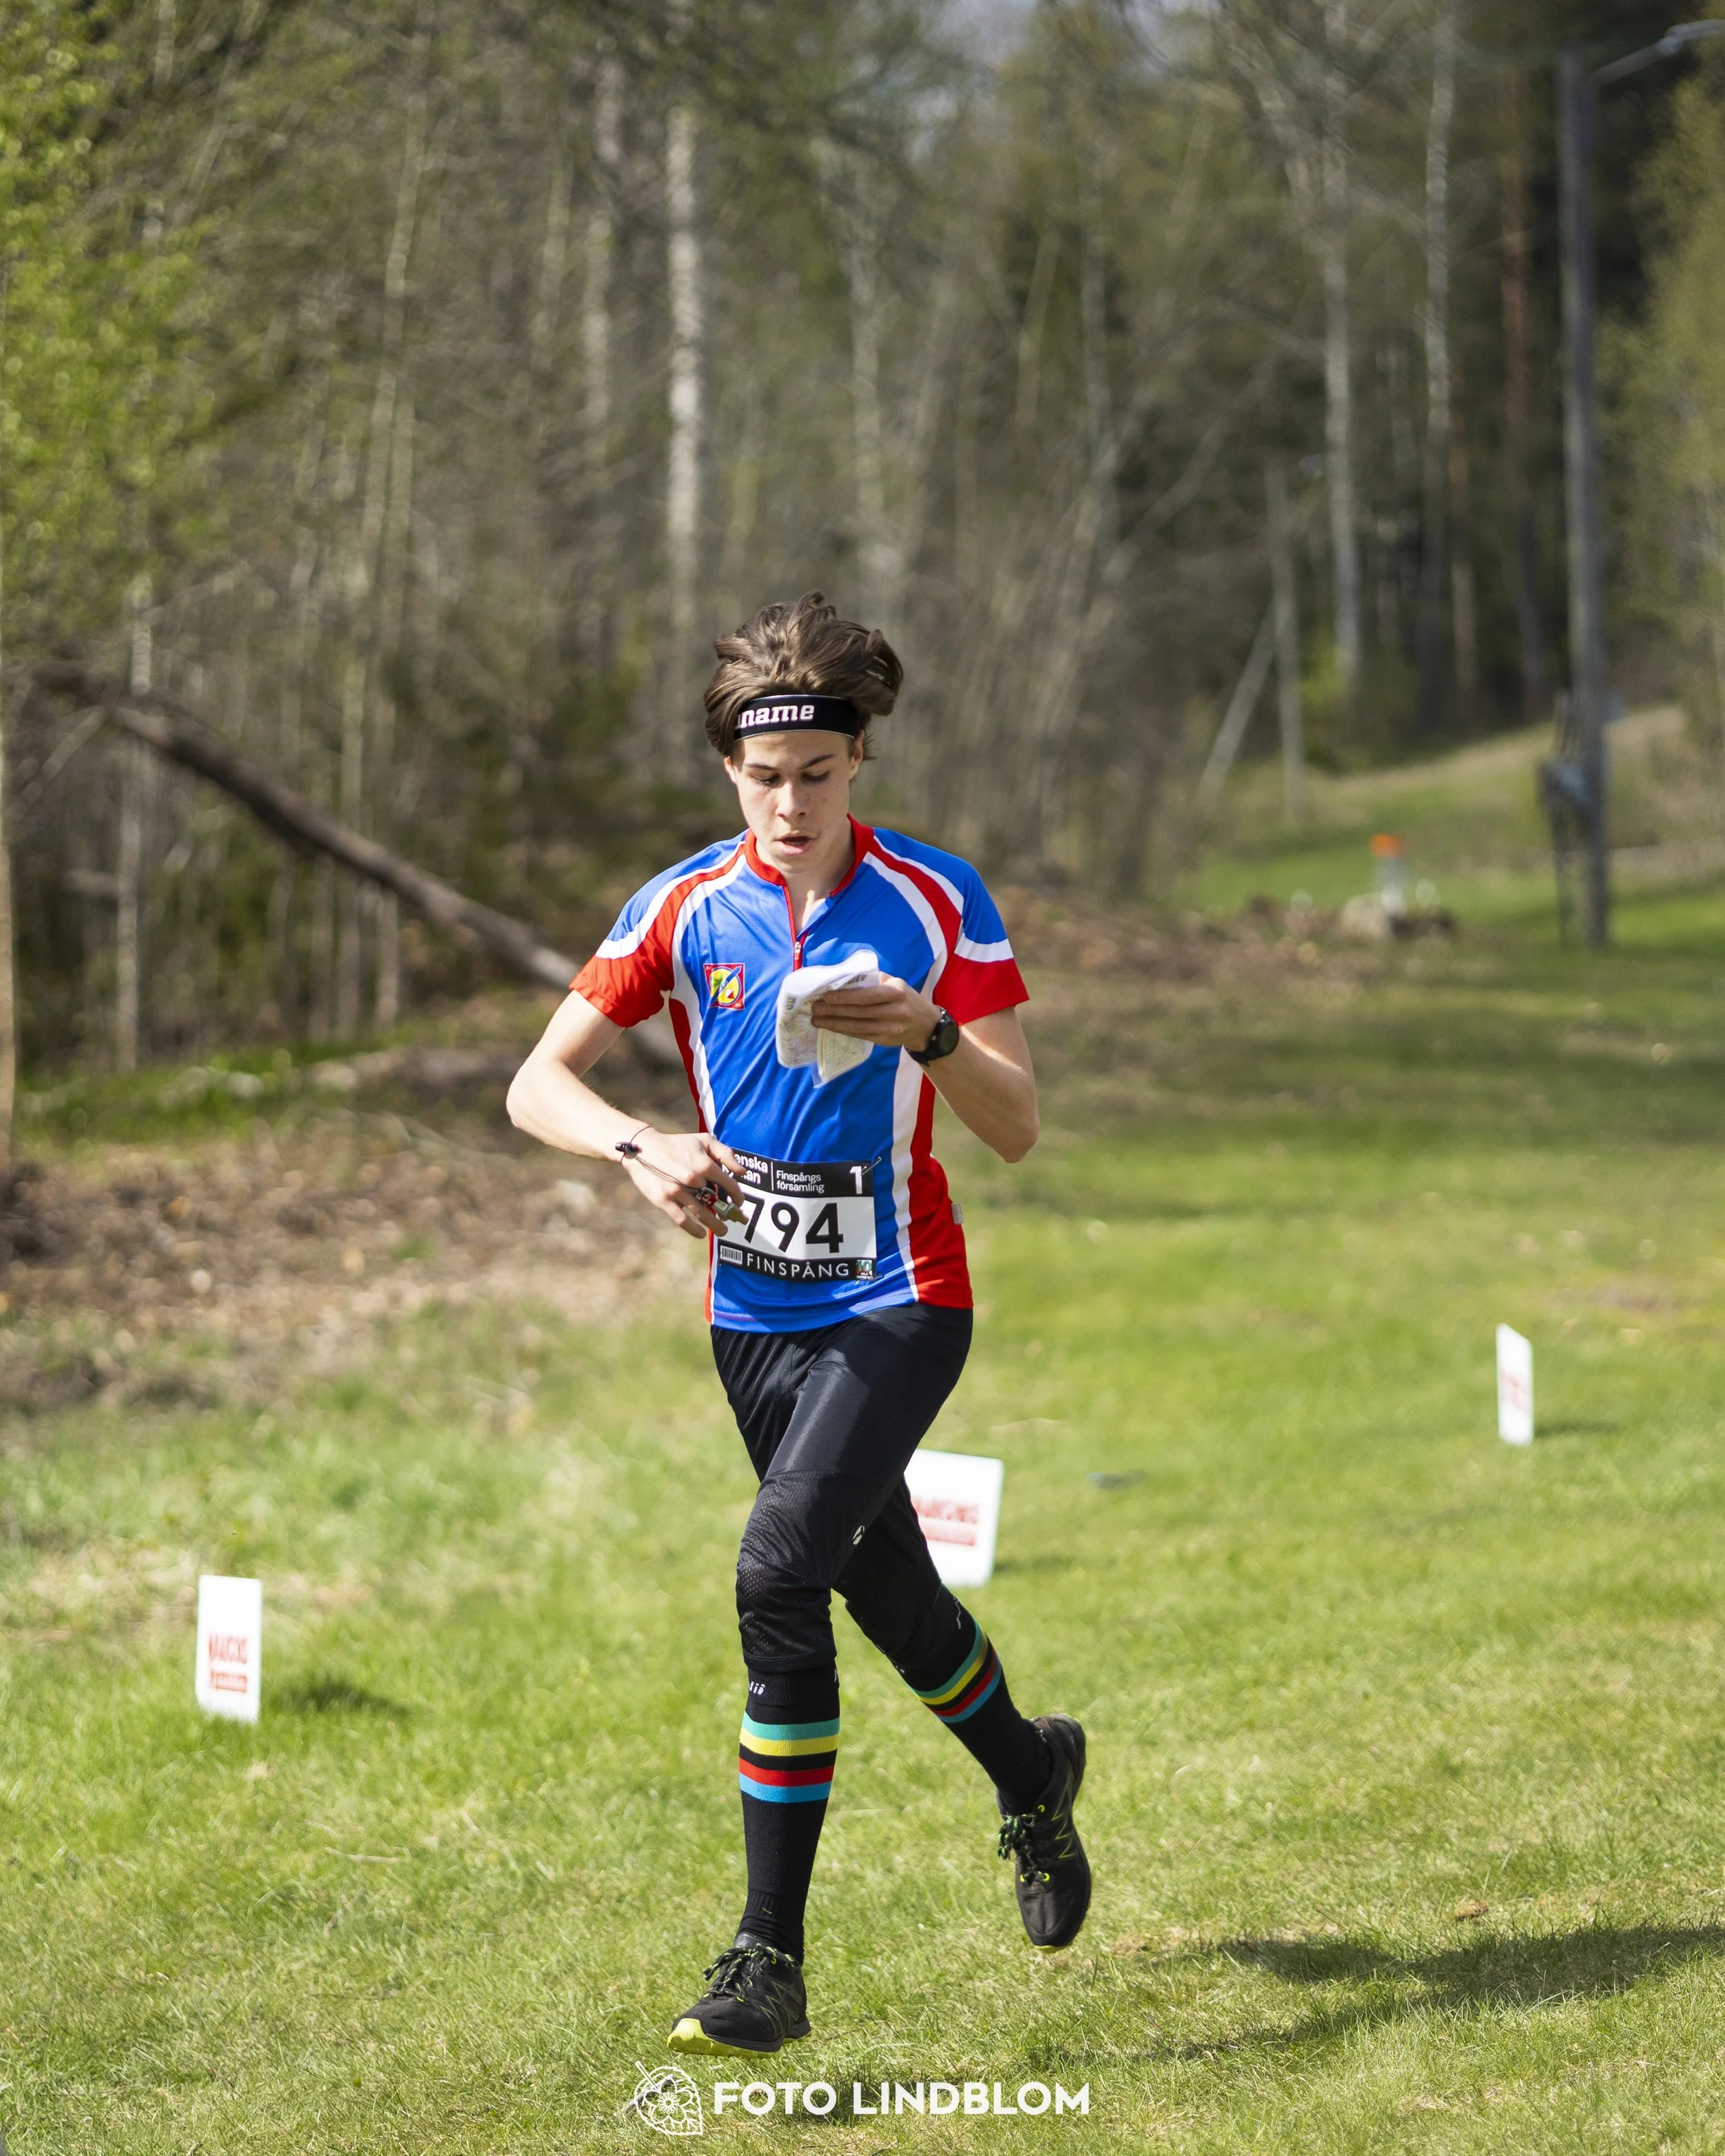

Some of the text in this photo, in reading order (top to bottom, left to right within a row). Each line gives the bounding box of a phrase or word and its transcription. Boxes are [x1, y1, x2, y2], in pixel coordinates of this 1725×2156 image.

[736, 704, 815, 729] name
[734, 1154, 769, 1174] enska
[776, 1169, 822, 1184] Finspångs
[776, 1180, 825, 1194] församling
[849, 1165, 862, 1194] 1
[743, 1191, 844, 1254] 794
[747, 1252, 849, 1278] FINSPÅNG
